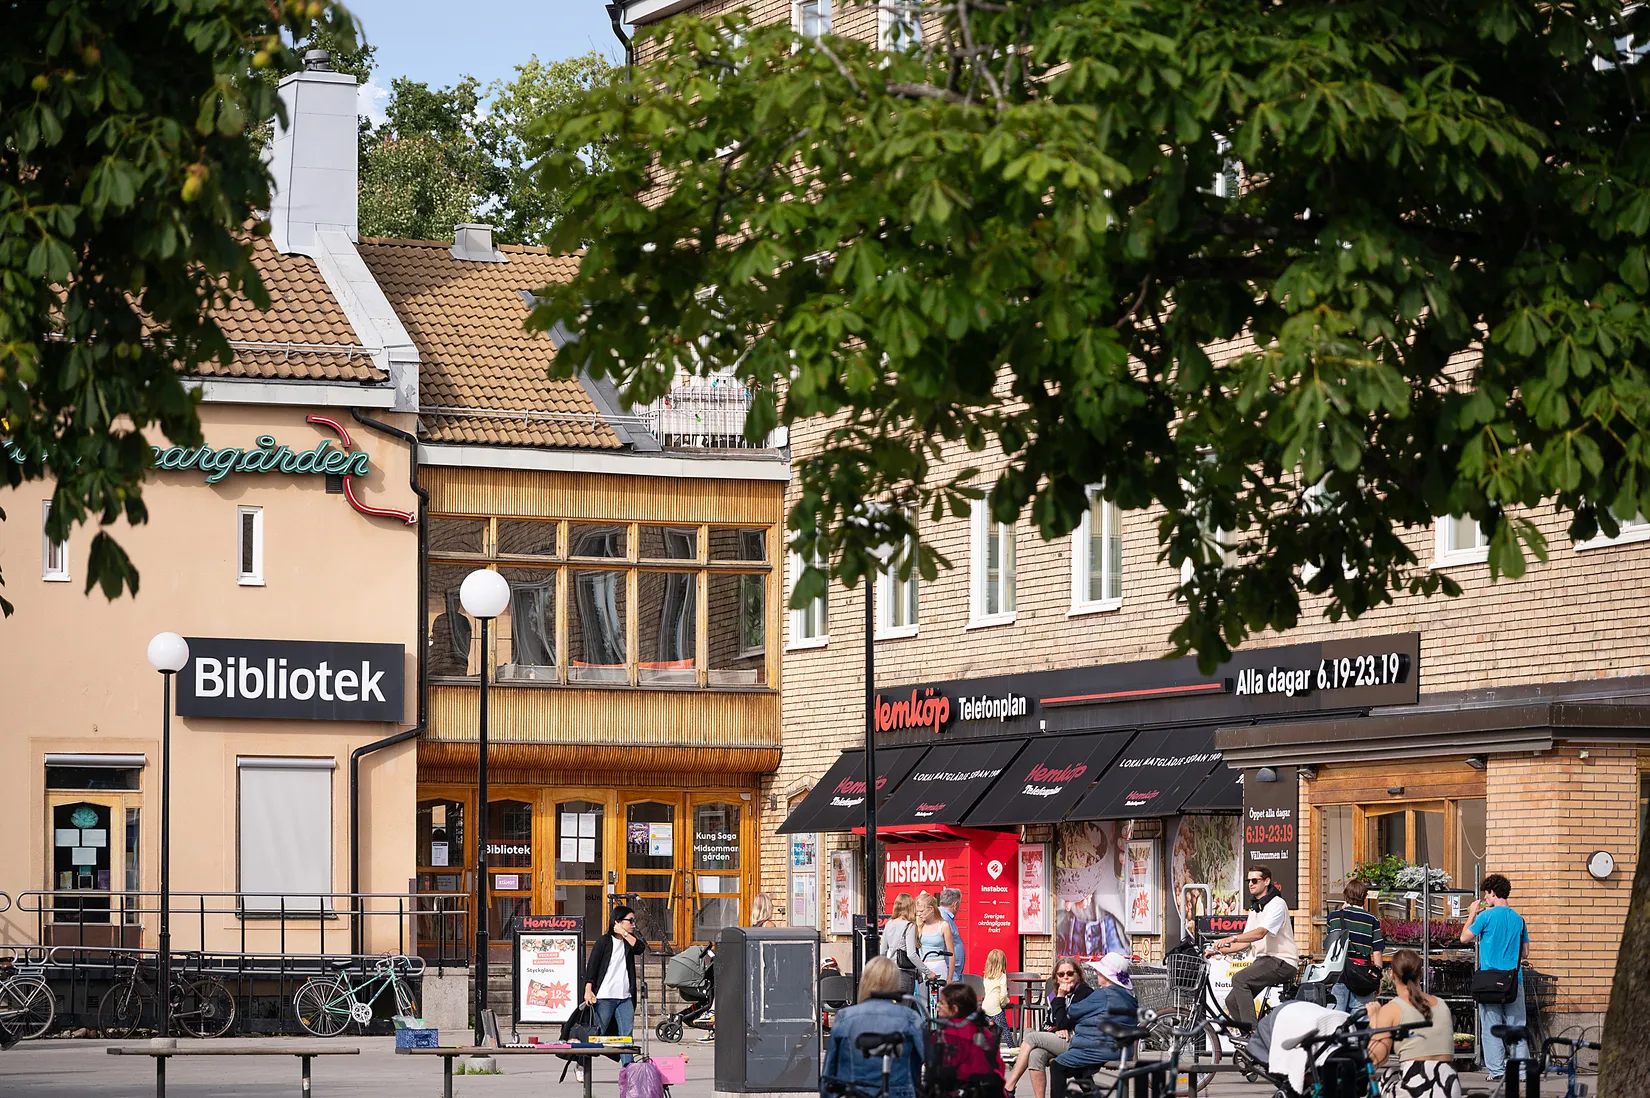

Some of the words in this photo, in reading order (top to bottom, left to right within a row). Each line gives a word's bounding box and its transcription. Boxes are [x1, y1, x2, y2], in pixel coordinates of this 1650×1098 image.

[149, 432, 370, 484] argården
[195, 656, 387, 702] Bibliotek
[1235, 668, 1264, 696] Alla
[1267, 666, 1311, 697] dagar
[1317, 652, 1400, 690] 6.19-23.19
[958, 692, 1027, 722] Telefonplan
[1023, 761, 1088, 783] Hemköp
[1249, 807, 1266, 821] Öppet
[1265, 808, 1276, 818] alla
[1275, 808, 1291, 820] dagar
[696, 832, 717, 841] Kung
[717, 832, 737, 841] Saga
[1245, 823, 1294, 844] 6:19-23:19
[693, 844, 739, 852] Midsommar
[702, 852, 730, 862] gården
[886, 850, 946, 884] instabox
[523, 917, 577, 930] Hemköp
[1210, 917, 1248, 931] Hem
